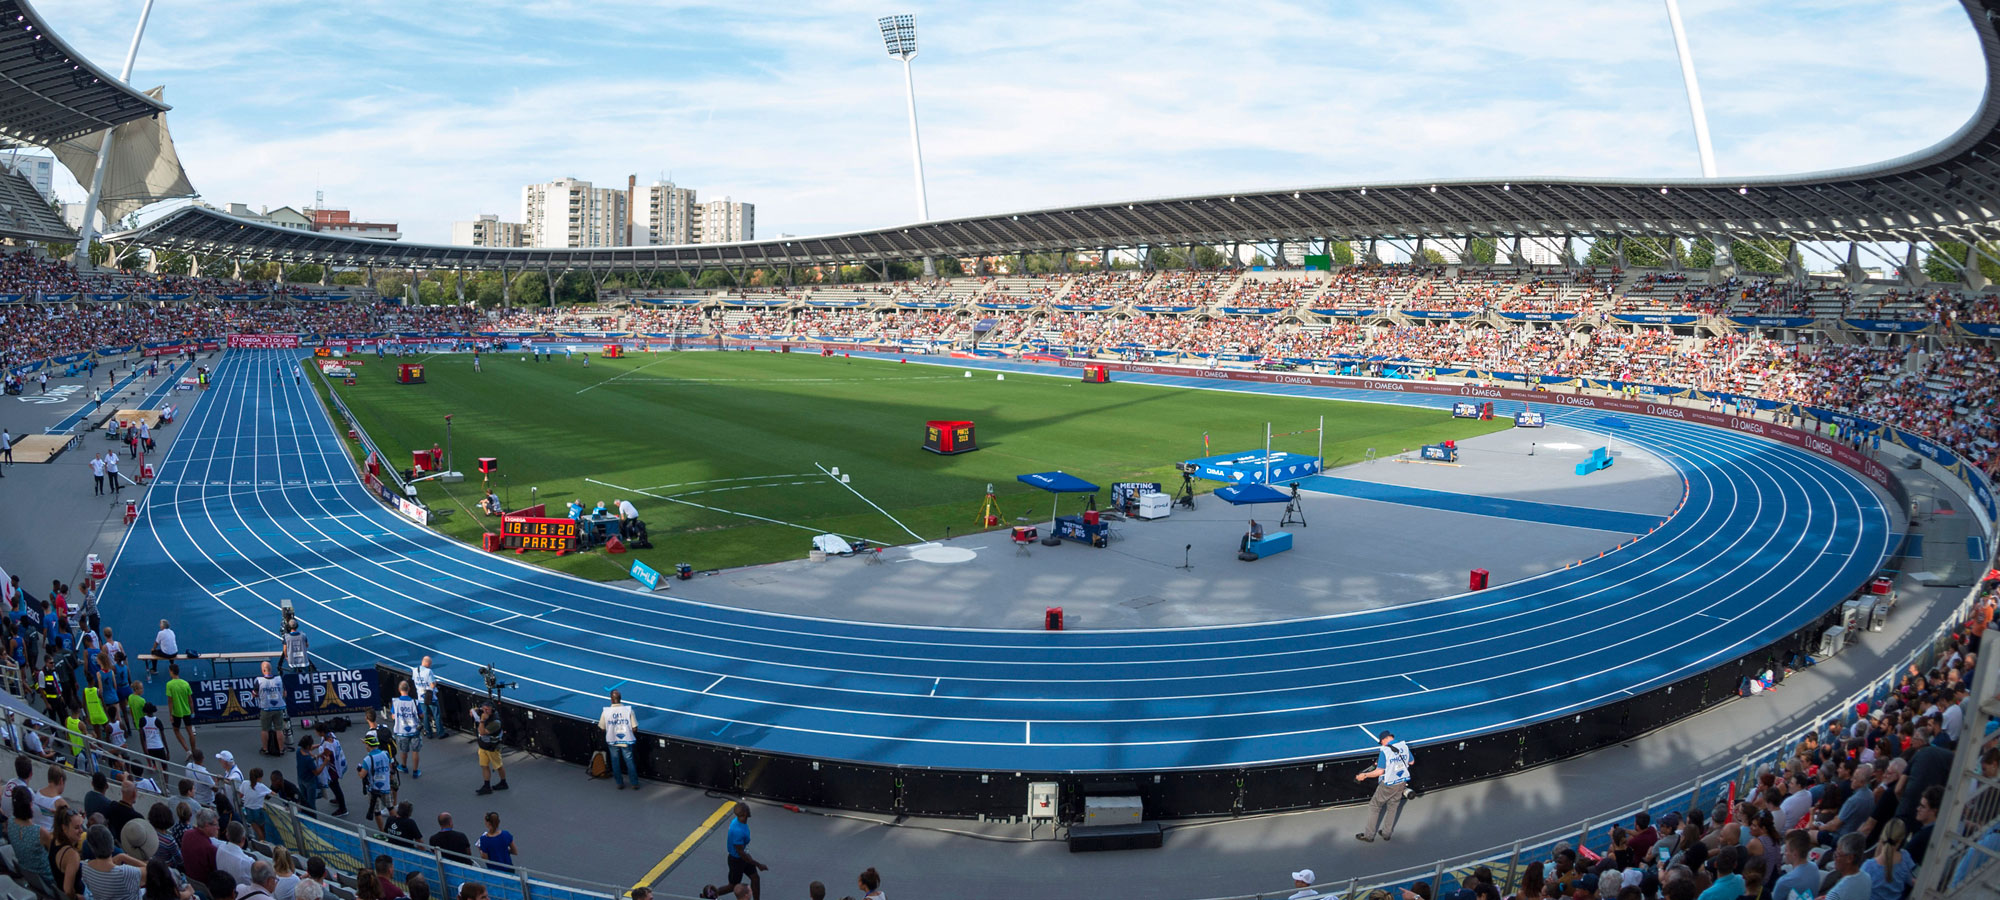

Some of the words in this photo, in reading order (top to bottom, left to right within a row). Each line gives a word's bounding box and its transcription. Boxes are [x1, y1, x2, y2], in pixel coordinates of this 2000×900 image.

[1285, 376, 1312, 384] OMEGA
[1374, 383, 1404, 391] OMEGA
[1566, 396, 1595, 407] OMEGA
[1656, 407, 1684, 418] OMEGA
[1740, 422, 1764, 434] OMEGA
[1812, 440, 1833, 456] OMEGA
[1207, 468, 1224, 476] DIMA
[1871, 466, 1887, 484] OMEGA
[509, 522, 574, 536] 18:15:20
[1068, 528, 1085, 538] PARIS
[523, 537, 566, 549] PARIS
[298, 670, 362, 684] MEETING
[201, 678, 254, 692] MEETIN
[294, 689, 310, 699] DE
[314, 682, 372, 703] PARIS
[197, 697, 212, 707] DE
[214, 690, 260, 710] PARI
